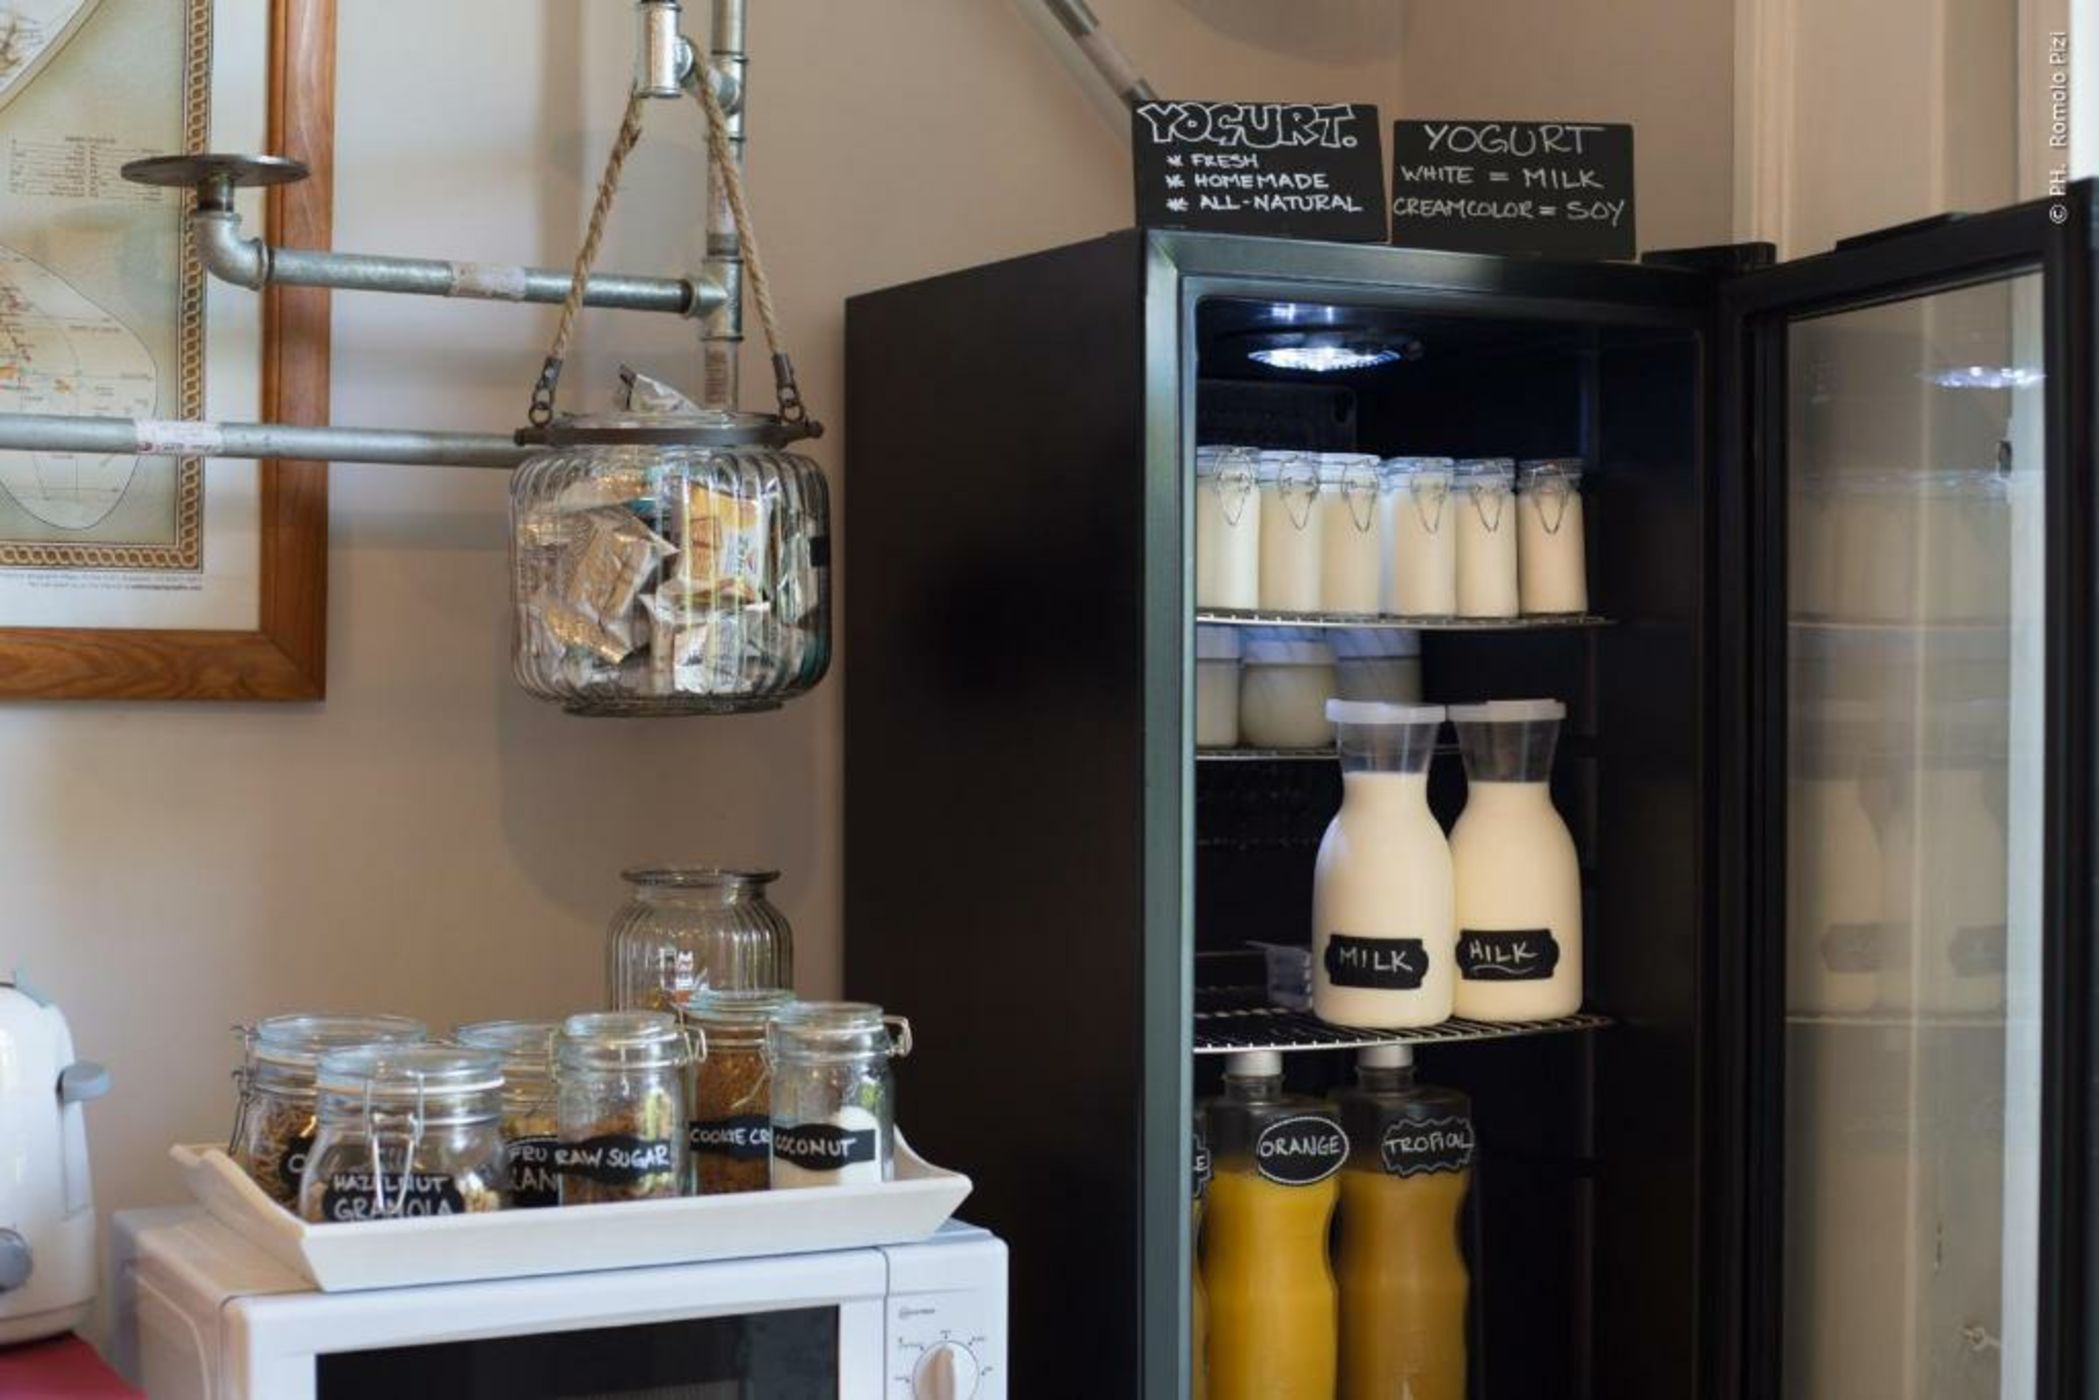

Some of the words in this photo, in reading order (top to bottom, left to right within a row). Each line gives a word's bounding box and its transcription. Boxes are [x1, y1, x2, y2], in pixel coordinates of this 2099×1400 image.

[1137, 103, 1358, 148] YOGURT.
[1424, 124, 1605, 156] YOGURT
[1191, 154, 1259, 168] FRESH
[1194, 173, 1329, 189] HOMEMADE
[1401, 166, 1474, 184] WHITE
[1522, 168, 1604, 189] MILK
[1200, 194, 1363, 212] ALL-NATURAL
[1393, 198, 1534, 219] CREAMCOLOR
[1566, 200, 1625, 227] SOY
[1338, 946, 1413, 973] MILK
[690, 1128, 747, 1146] COOKIE
[1259, 1134, 1341, 1157] ORANGE
[554, 1148, 602, 1168] RAW
[606, 1144, 670, 1169] SUGAR
